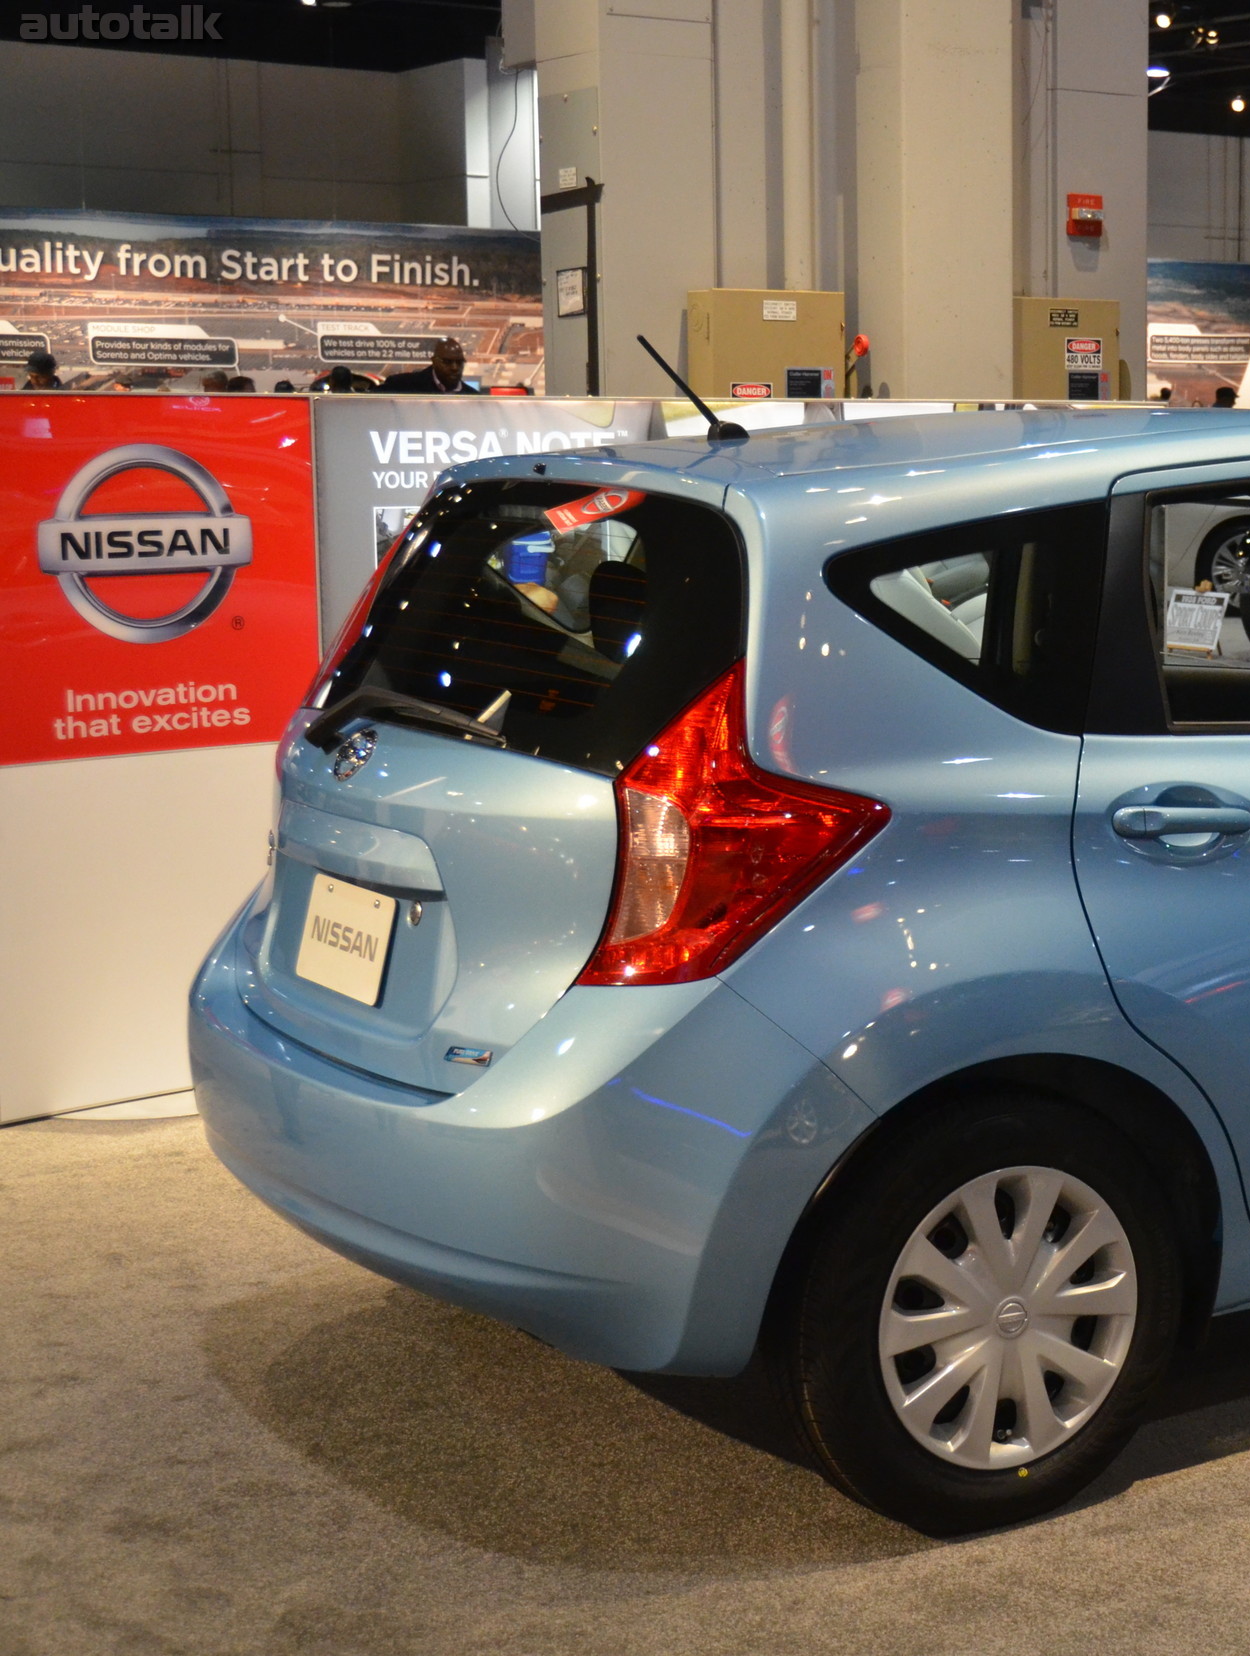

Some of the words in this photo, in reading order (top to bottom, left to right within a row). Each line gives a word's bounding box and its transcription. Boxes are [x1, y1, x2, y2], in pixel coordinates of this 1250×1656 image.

[117, 244, 207, 279] from
[221, 249, 309, 282] Start
[321, 253, 358, 282] to
[371, 254, 480, 286] Finish.
[133, 325, 156, 333] SHOP
[342, 324, 369, 332] TRACK
[95, 341, 131, 350] Provides
[132, 341, 149, 350] four
[150, 341, 172, 350] kinds
[173, 342, 182, 350] of
[183, 342, 217, 351] modules
[218, 343, 230, 351] for
[324, 340, 338, 348] We
[339, 340, 354, 348] test
[355, 340, 375, 348] drive
[376, 340, 396, 348] 100%
[397, 340, 407, 348] of
[1071, 342, 1096, 351] DANGER
[1, 349, 34, 358] vehicle
[96, 351, 129, 359] Sorento
[130, 351, 146, 359] and
[148, 352, 178, 361] Optima
[324, 349, 355, 357] vehicles
[382, 350, 394, 358] 2.2
[394, 350, 411, 358] mile
[412, 350, 427, 358] test
[1066, 355, 1079, 364] 480
[1080, 355, 1101, 364] VOLTS
[736, 386, 767, 396] DANGER
[372, 471, 429, 489] YOUR
[60, 528, 231, 561] NISSAN
[66, 681, 238, 713] Innovation
[53, 713, 121, 740] that
[132, 707, 251, 733] excites
[310, 915, 379, 962] NISSAN
